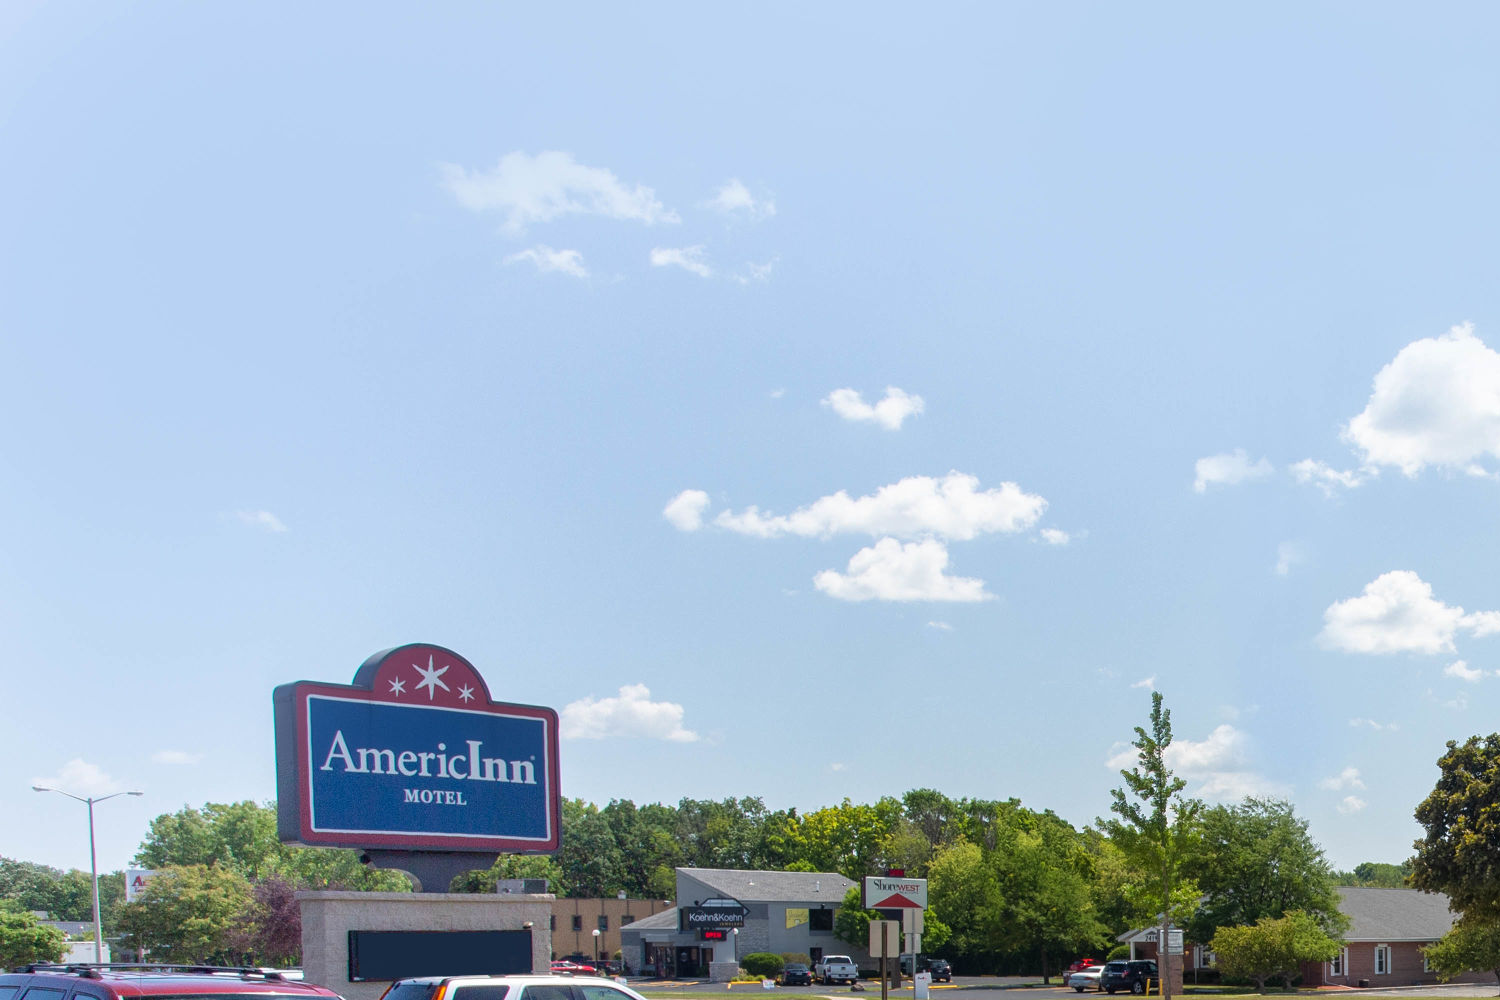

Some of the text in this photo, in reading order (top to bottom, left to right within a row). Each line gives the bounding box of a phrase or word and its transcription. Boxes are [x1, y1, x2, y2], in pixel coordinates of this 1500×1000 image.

[320, 730, 537, 784] AmericInn
[404, 789, 467, 805] MOTEL
[689, 913, 743, 922] Koehn&Koehn
